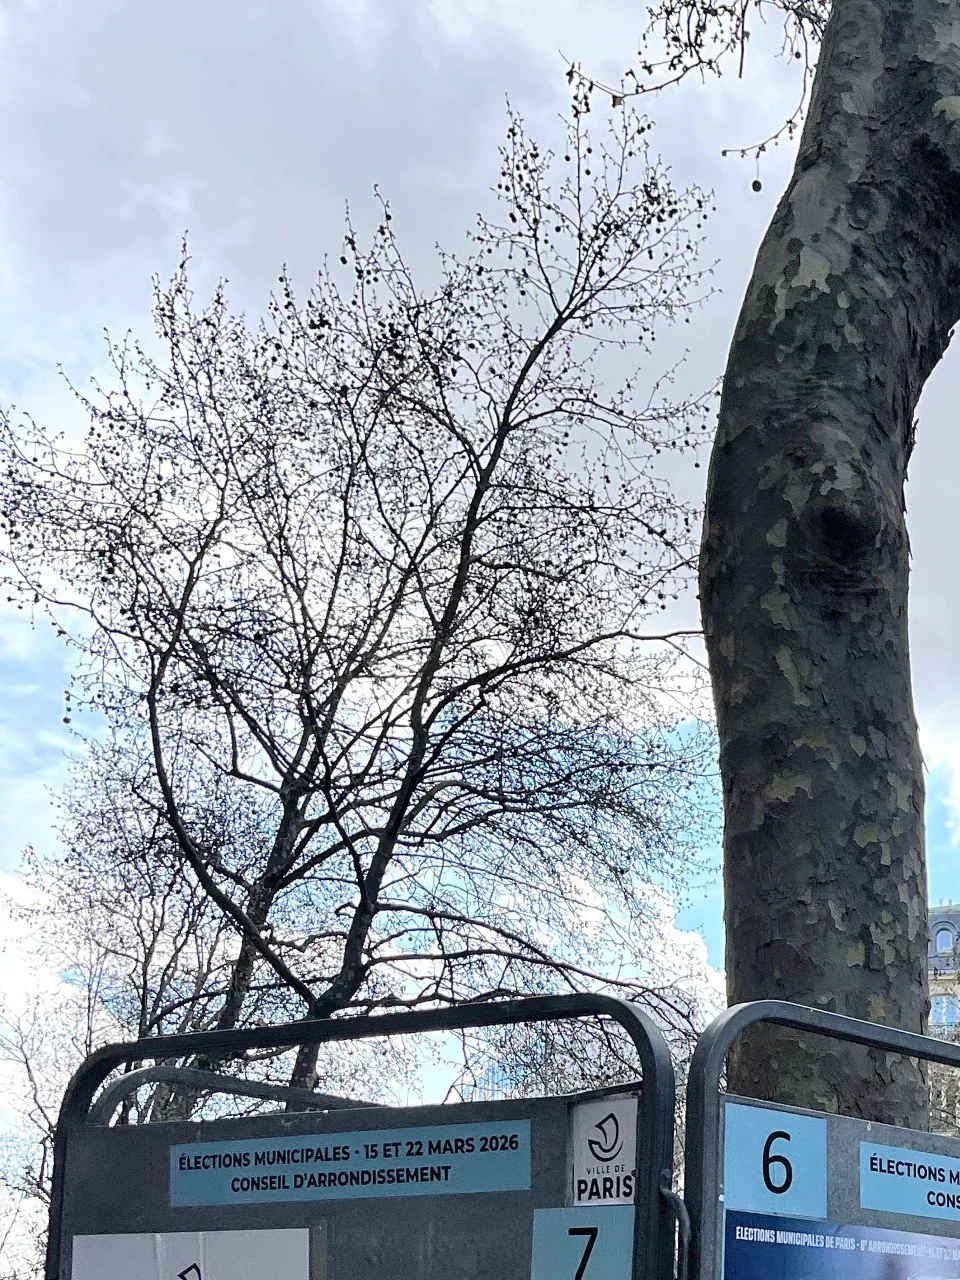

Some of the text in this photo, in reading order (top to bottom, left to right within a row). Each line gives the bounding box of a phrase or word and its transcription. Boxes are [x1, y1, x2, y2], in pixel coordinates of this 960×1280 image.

[178, 1134, 519, 1171] ÉLECTIONS MUNICIPALES 15 ET 22 MARS 2026
[761, 1130, 793, 1195] 6
[231, 1165, 452, 1193] CONSEIL D'ARRONDISSEMENT
[586, 1164, 625, 1175] VILLE DE
[869, 1155, 946, 1184] ÉLECTIONS
[577, 1175, 633, 1201] PARIS
[735, 1225, 856, 1250] ÉLECTIONS MUNICIPALES DE PARIS
